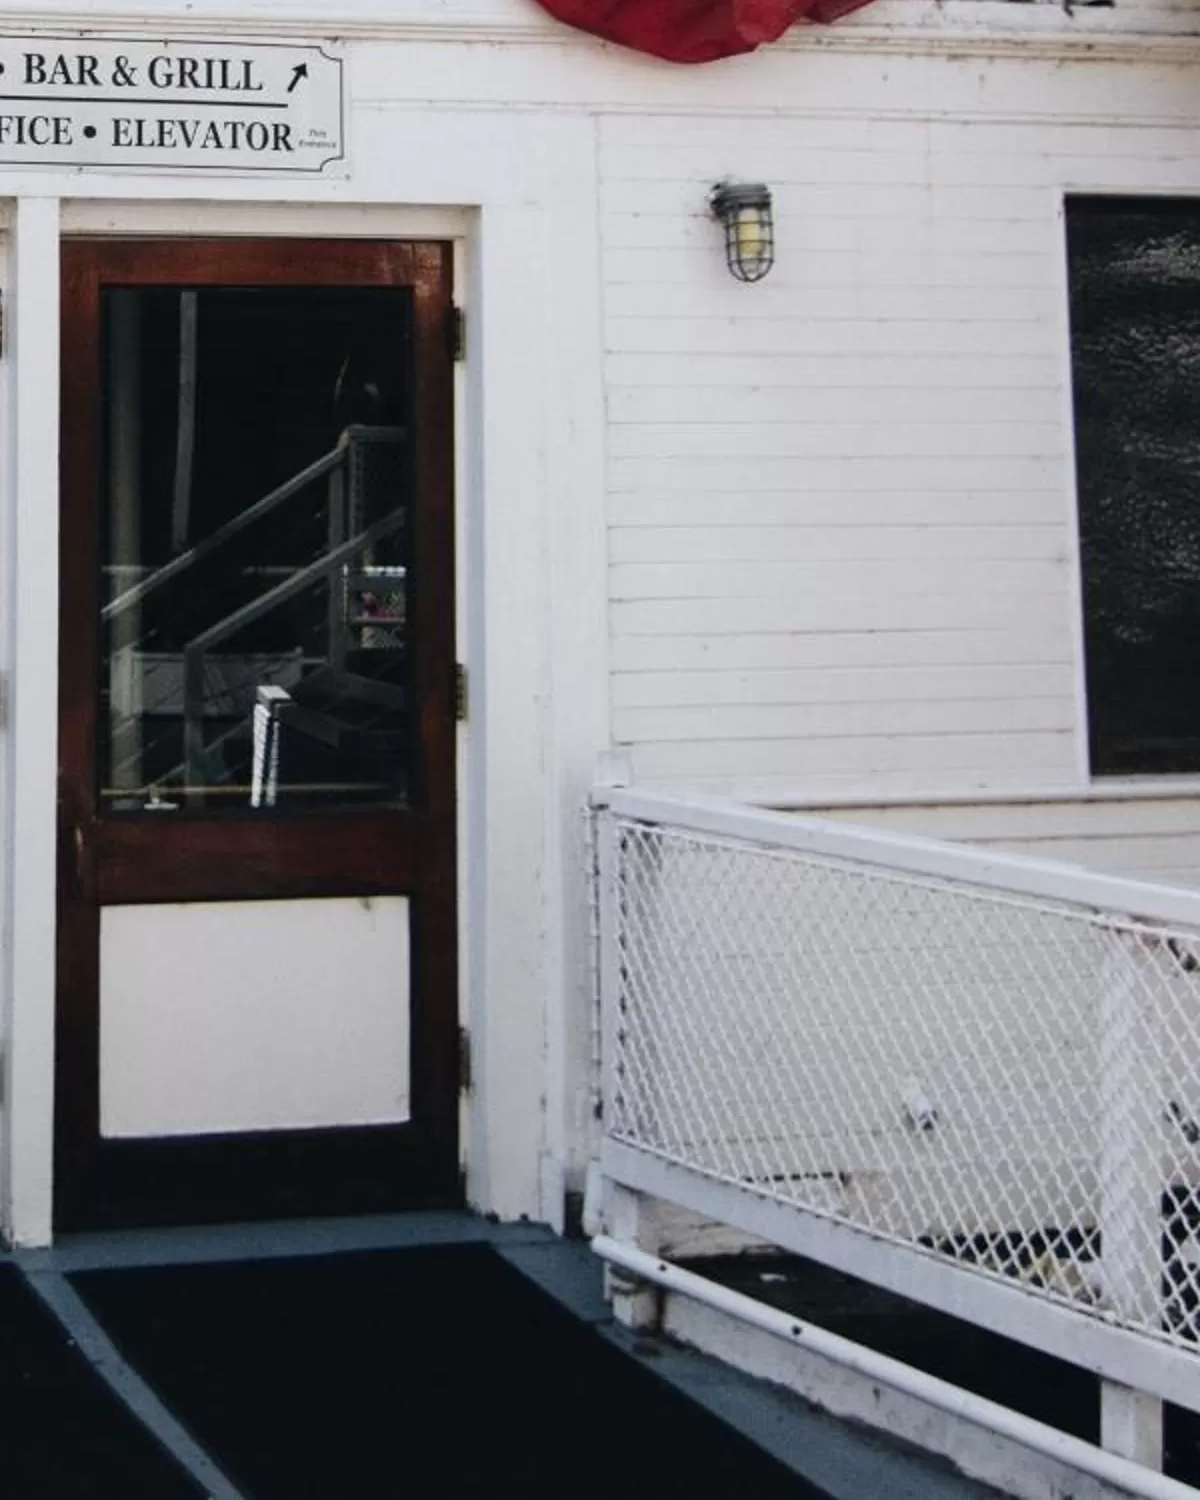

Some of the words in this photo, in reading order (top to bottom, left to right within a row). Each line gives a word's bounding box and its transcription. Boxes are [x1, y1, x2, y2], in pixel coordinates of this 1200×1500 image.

[23, 53, 102, 87] BAR
[111, 55, 138, 88] &
[148, 57, 264, 91] GRILL
[111, 118, 294, 152] ELEVATOR
